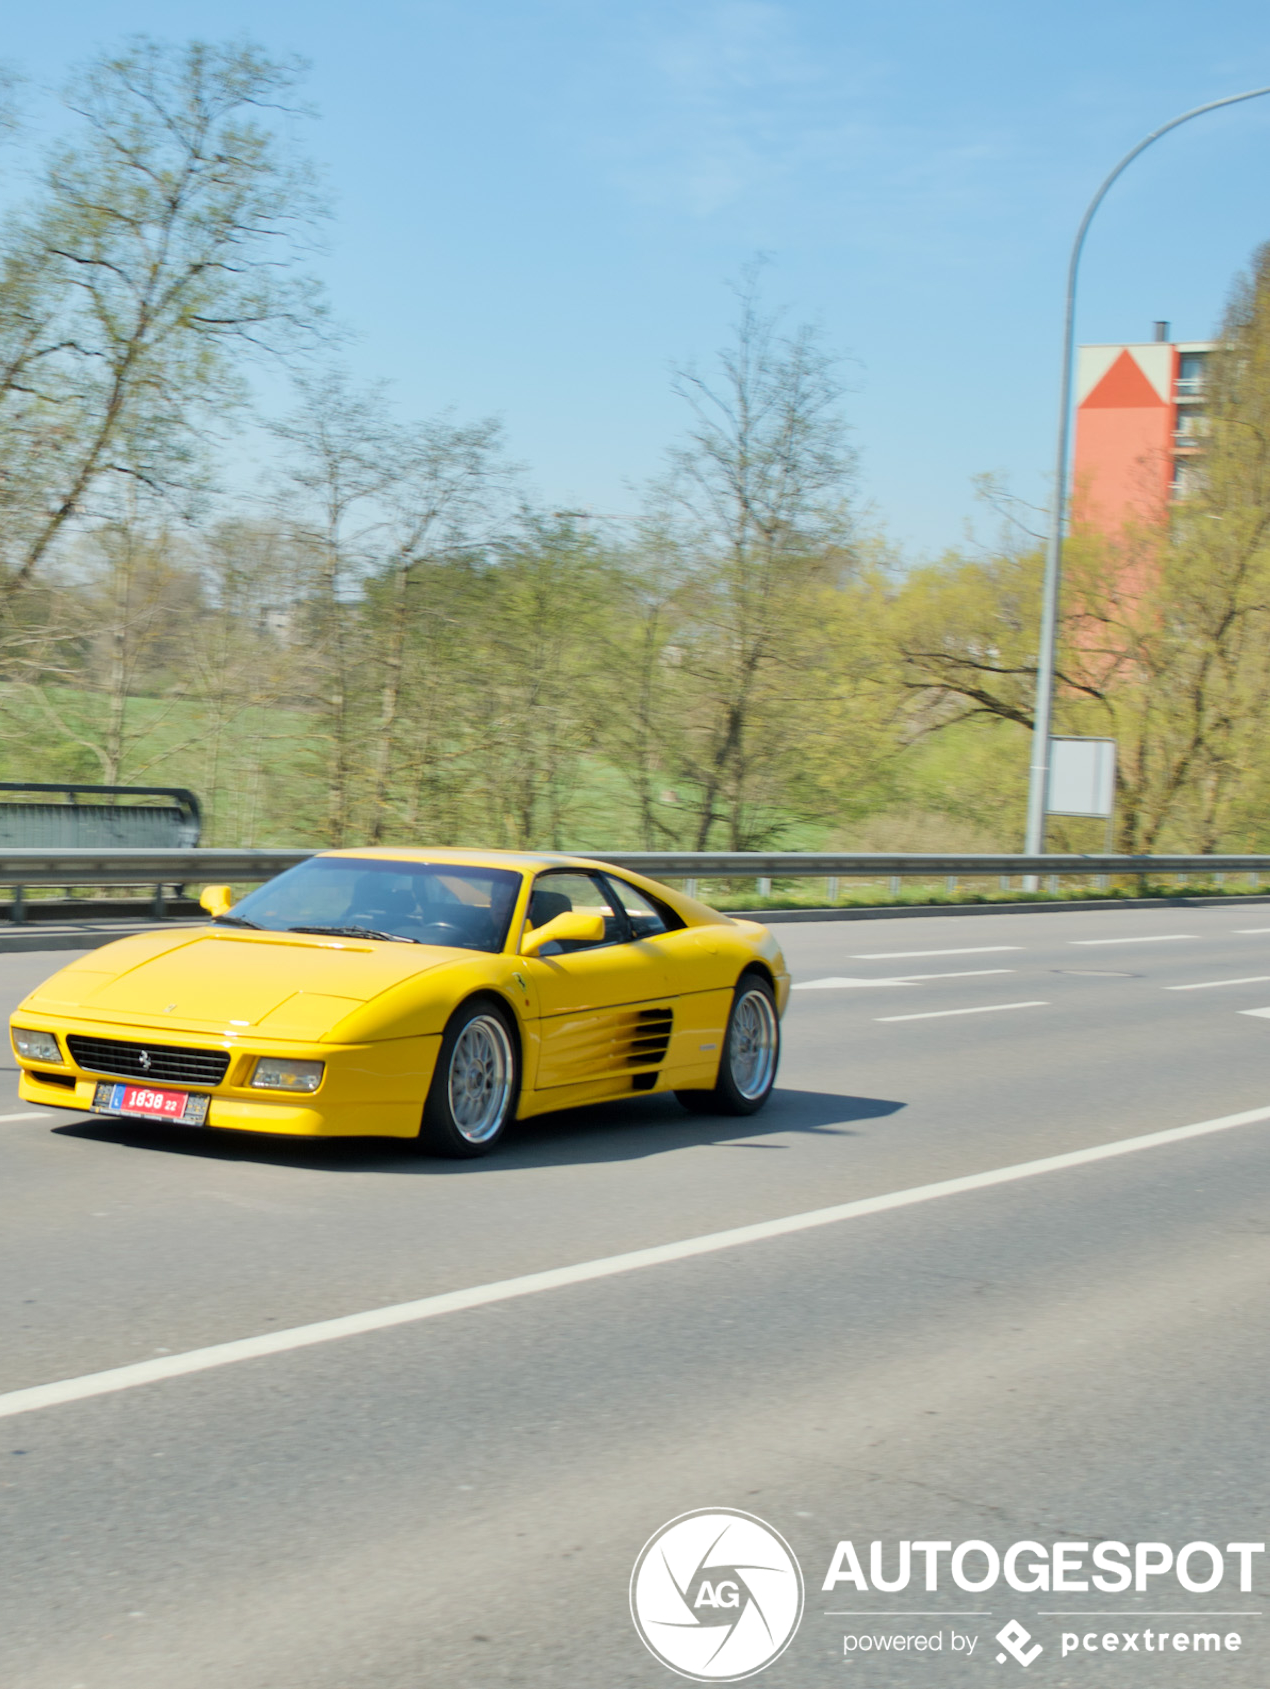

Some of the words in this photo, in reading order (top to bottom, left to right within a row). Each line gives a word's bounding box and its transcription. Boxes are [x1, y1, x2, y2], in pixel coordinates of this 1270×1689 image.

[114, 1098, 119, 1107] L
[129, 1091, 164, 1108] 1838
[165, 1100, 177, 1111] 22
